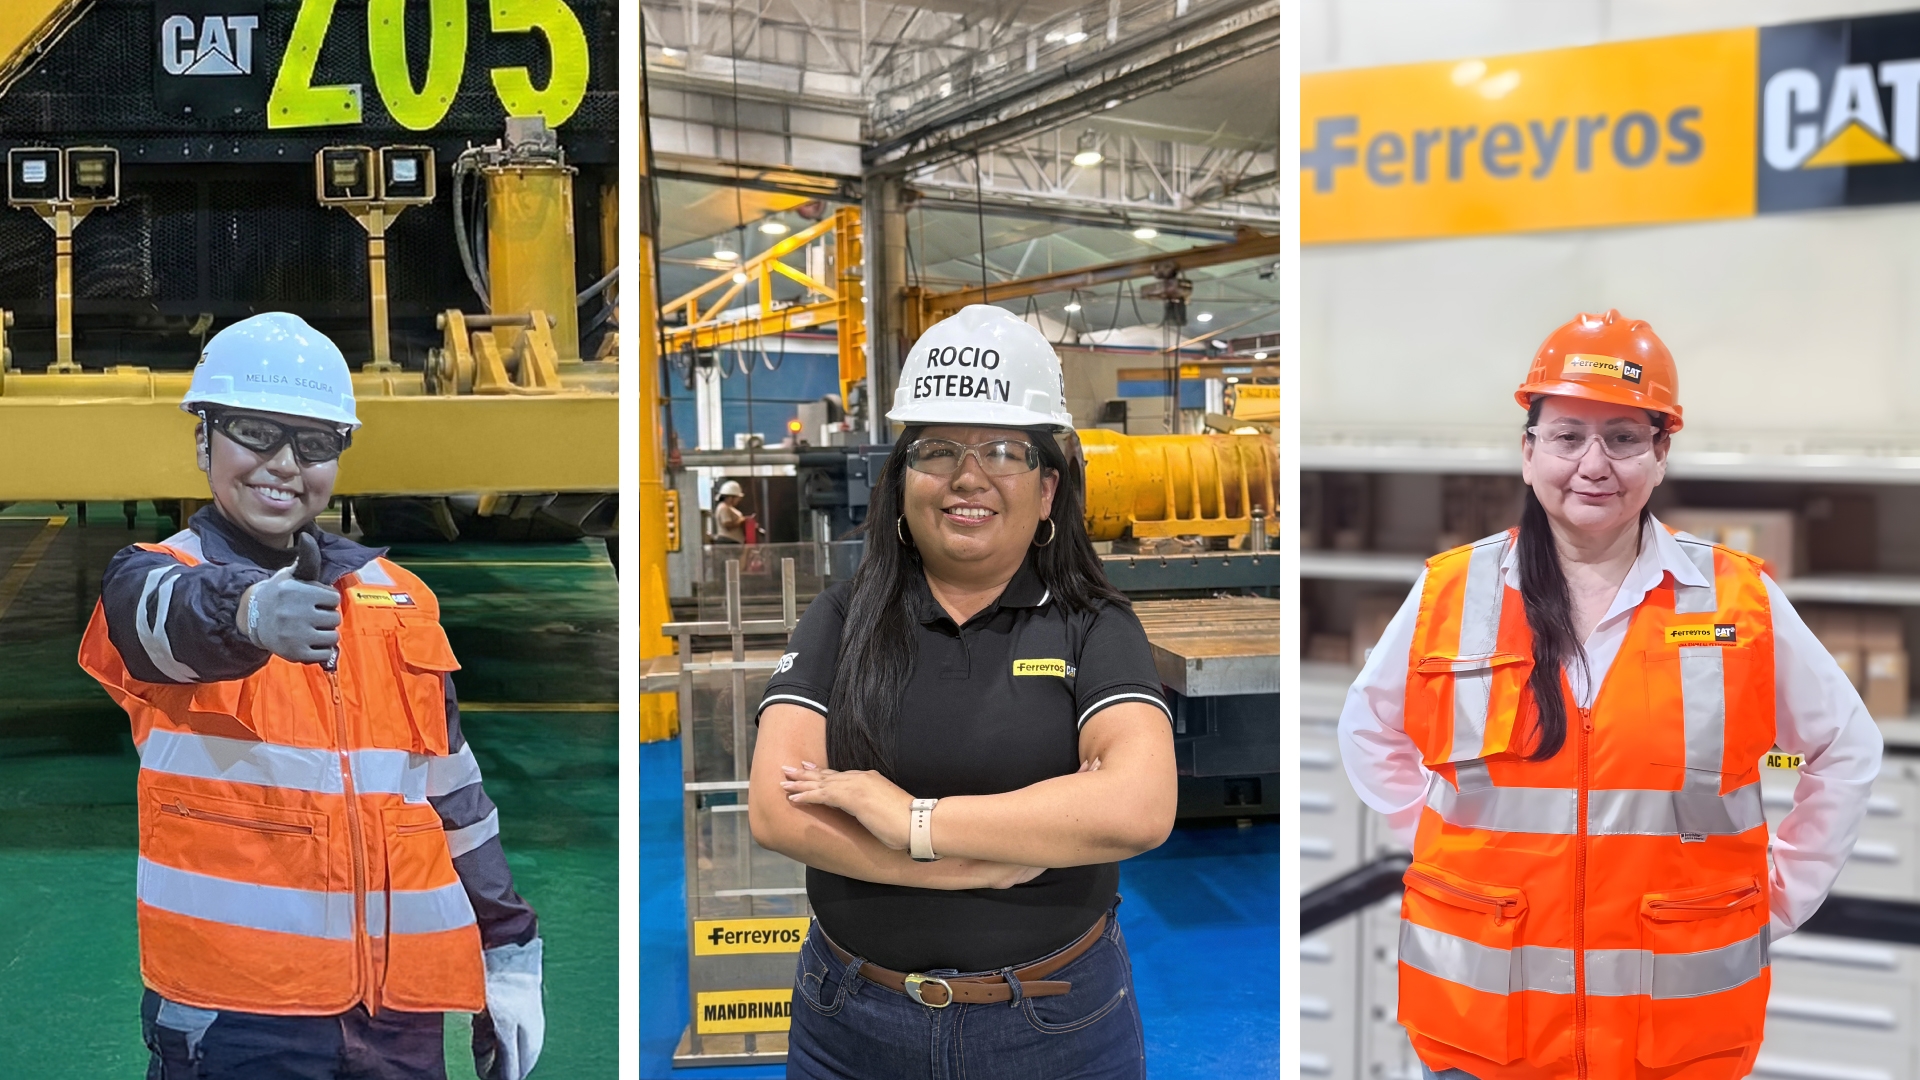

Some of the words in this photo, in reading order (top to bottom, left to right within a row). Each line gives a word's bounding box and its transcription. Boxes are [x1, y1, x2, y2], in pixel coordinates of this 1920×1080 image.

[161, 15, 259, 75] CAT
[1300, 106, 1705, 193] Ferreyros
[1763, 59, 1920, 171] CAT
[927, 346, 1000, 370] ROCIO
[1624, 365, 1641, 379] CAT
[246, 374, 288, 384] MELISA
[295, 377, 334, 394] SEGURA
[913, 375, 1010, 402] ESTEBAN
[1017, 663, 1065, 672] Ferreyros
[1767, 755, 1781, 767] AC
[1787, 756, 1800, 768] 14
[708, 927, 800, 946] Ferreyros
[704, 1001, 792, 1022] MANDRINAD
